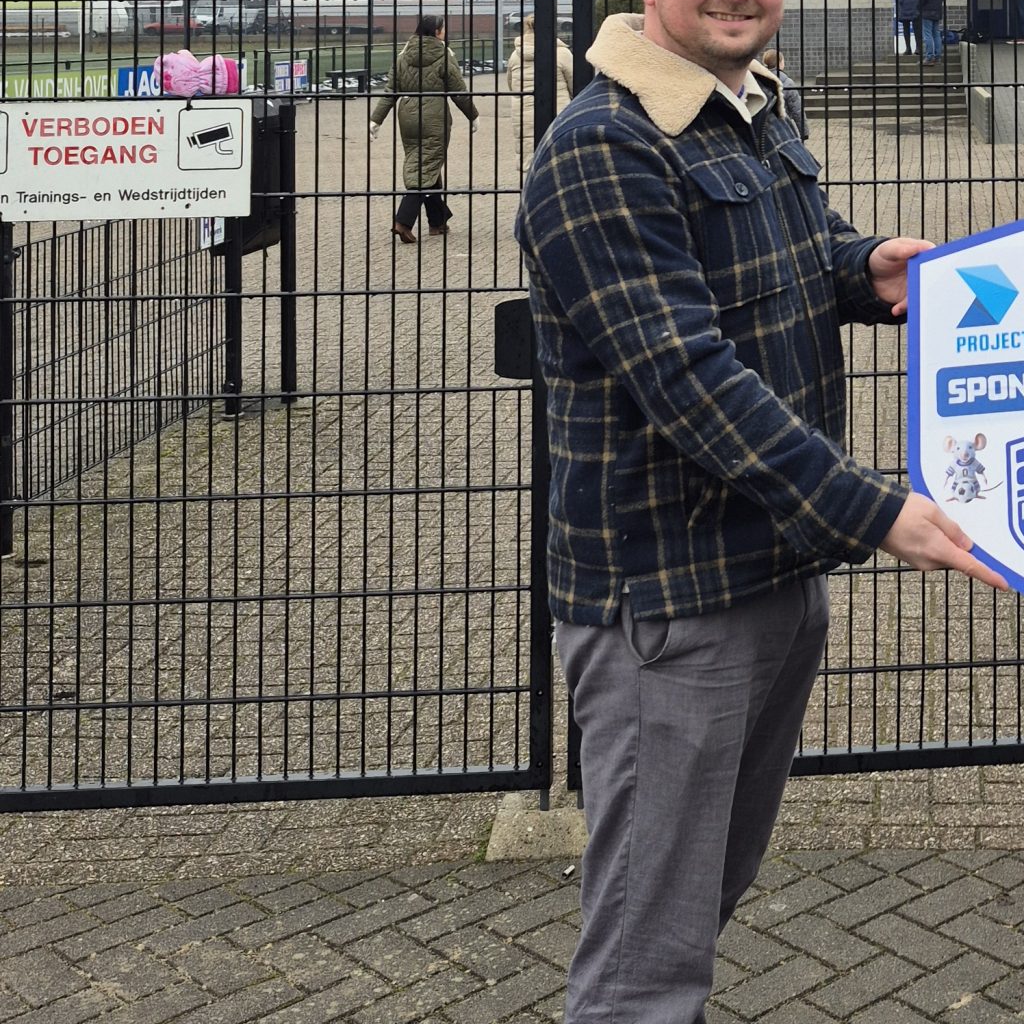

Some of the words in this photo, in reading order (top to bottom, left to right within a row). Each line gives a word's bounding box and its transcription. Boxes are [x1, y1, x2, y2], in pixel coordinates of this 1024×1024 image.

[21, 115, 165, 138] VERBODEN
[27, 144, 158, 166] TOEGANG
[16, 190, 87, 205] Trainings-
[93, 191, 111, 202] en
[118, 187, 226, 203] Wedstrijdtijden
